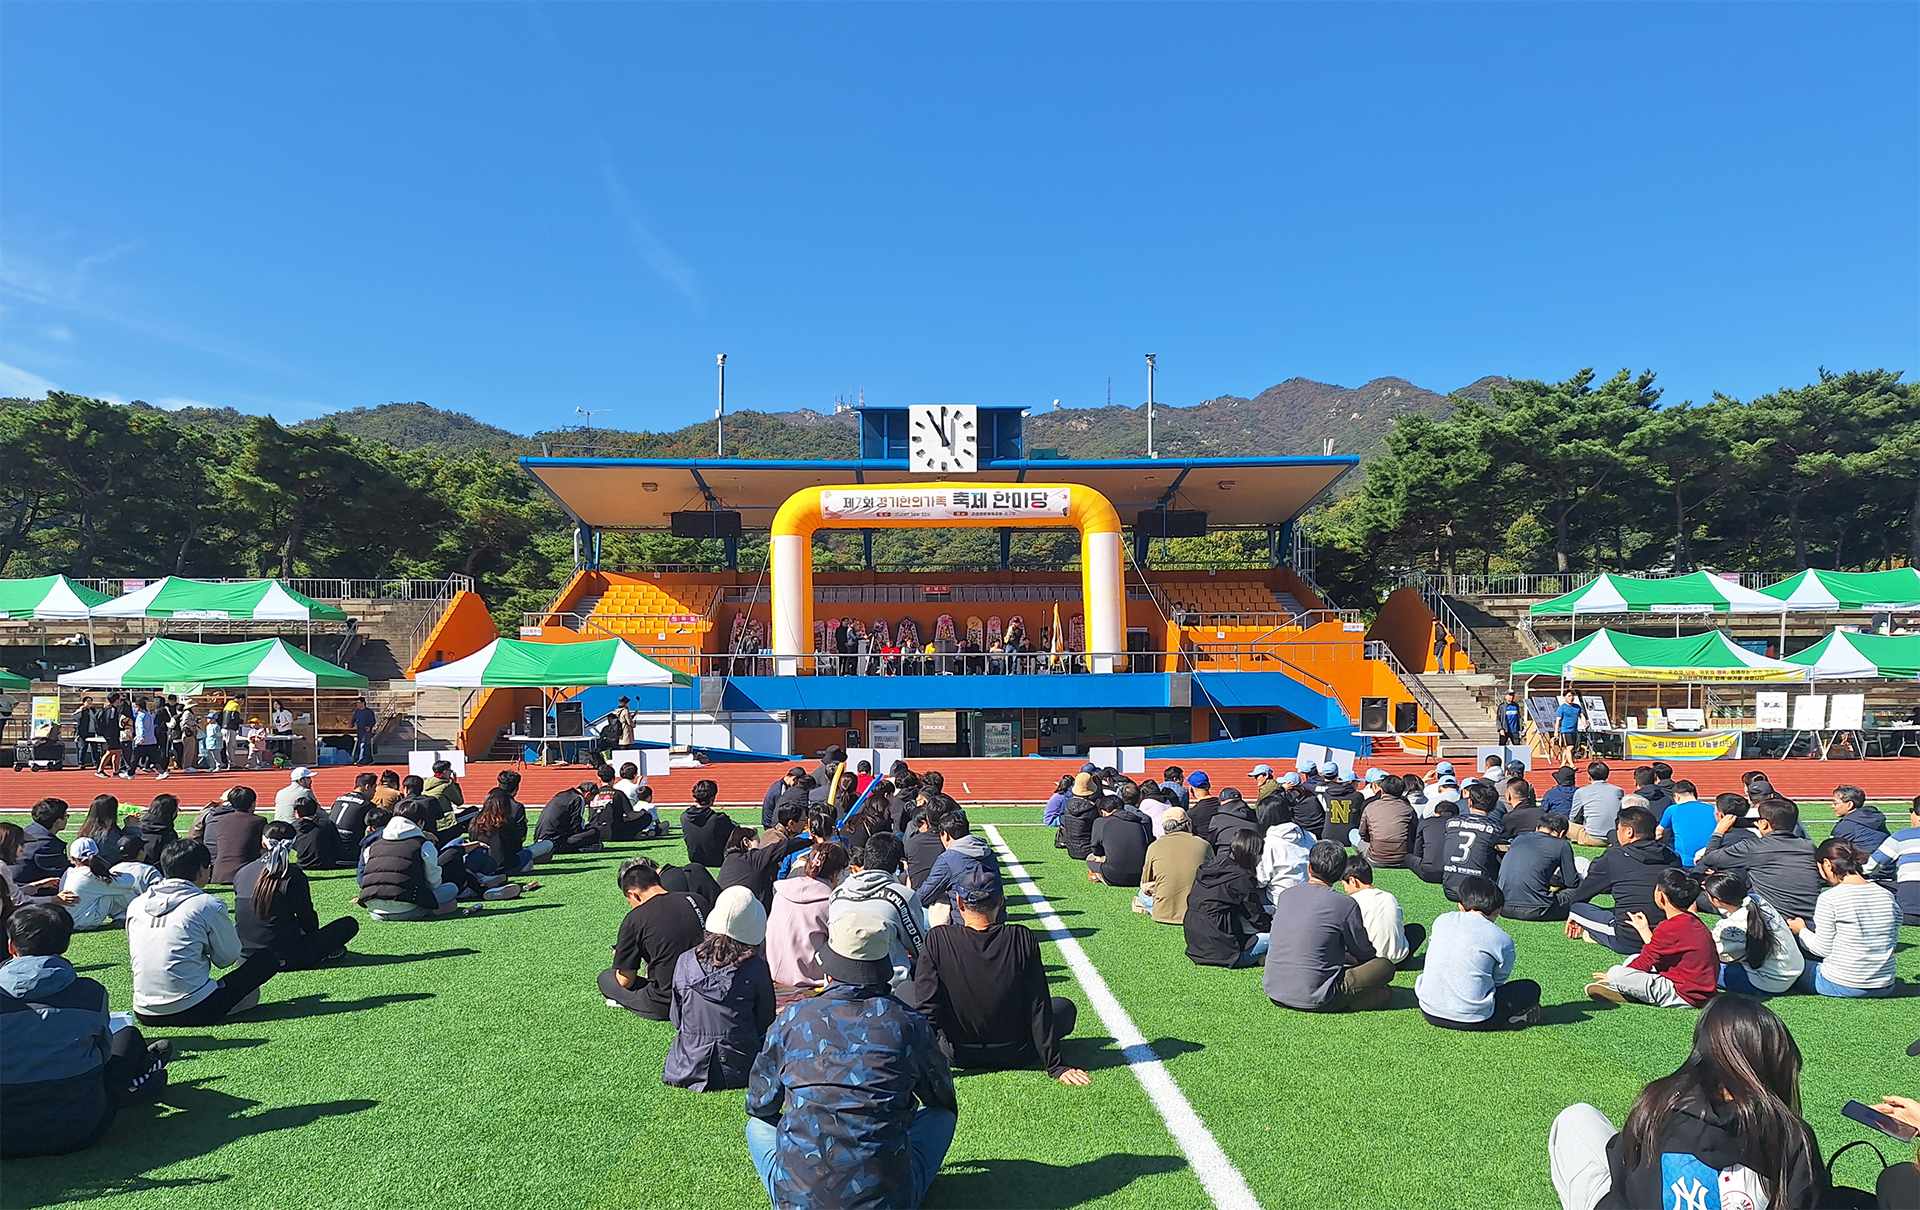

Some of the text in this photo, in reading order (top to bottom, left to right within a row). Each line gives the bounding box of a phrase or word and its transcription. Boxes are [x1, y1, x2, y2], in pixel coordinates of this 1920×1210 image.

[843, 496, 874, 509] 제7회
[877, 495, 947, 508] 경기한의가족
[953, 491, 987, 509] 축제
[1330, 800, 1352, 824] N
[1450, 831, 1477, 864] 3
[886, 891, 917, 936] UNLIMITED
